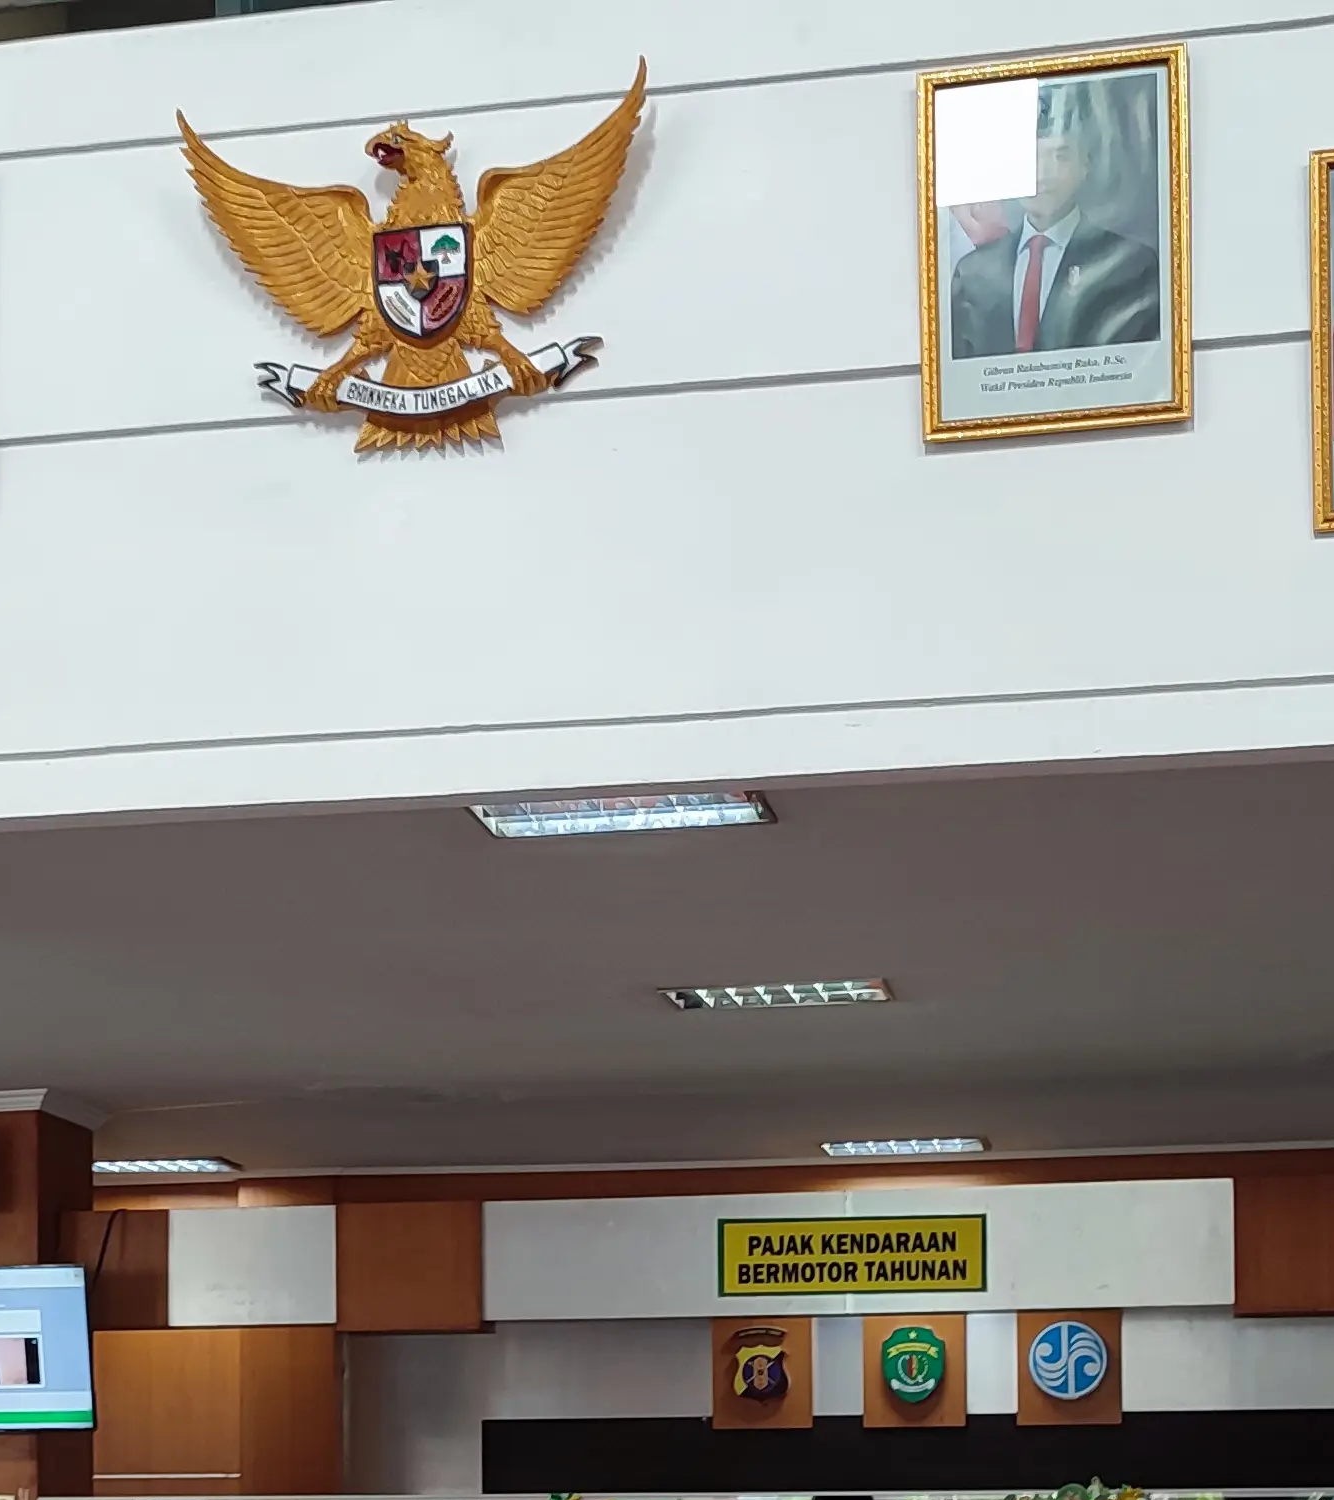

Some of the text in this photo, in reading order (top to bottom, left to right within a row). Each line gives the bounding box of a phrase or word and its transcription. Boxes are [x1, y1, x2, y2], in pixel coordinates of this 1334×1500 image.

[413, 386, 473, 412] TUNGGAL
[480, 373, 505, 395] IKA
[748, 1230, 958, 1257] PAJAK KENDARAAN
[737, 1258, 968, 1285] BERMOTOR TAHUNAN
